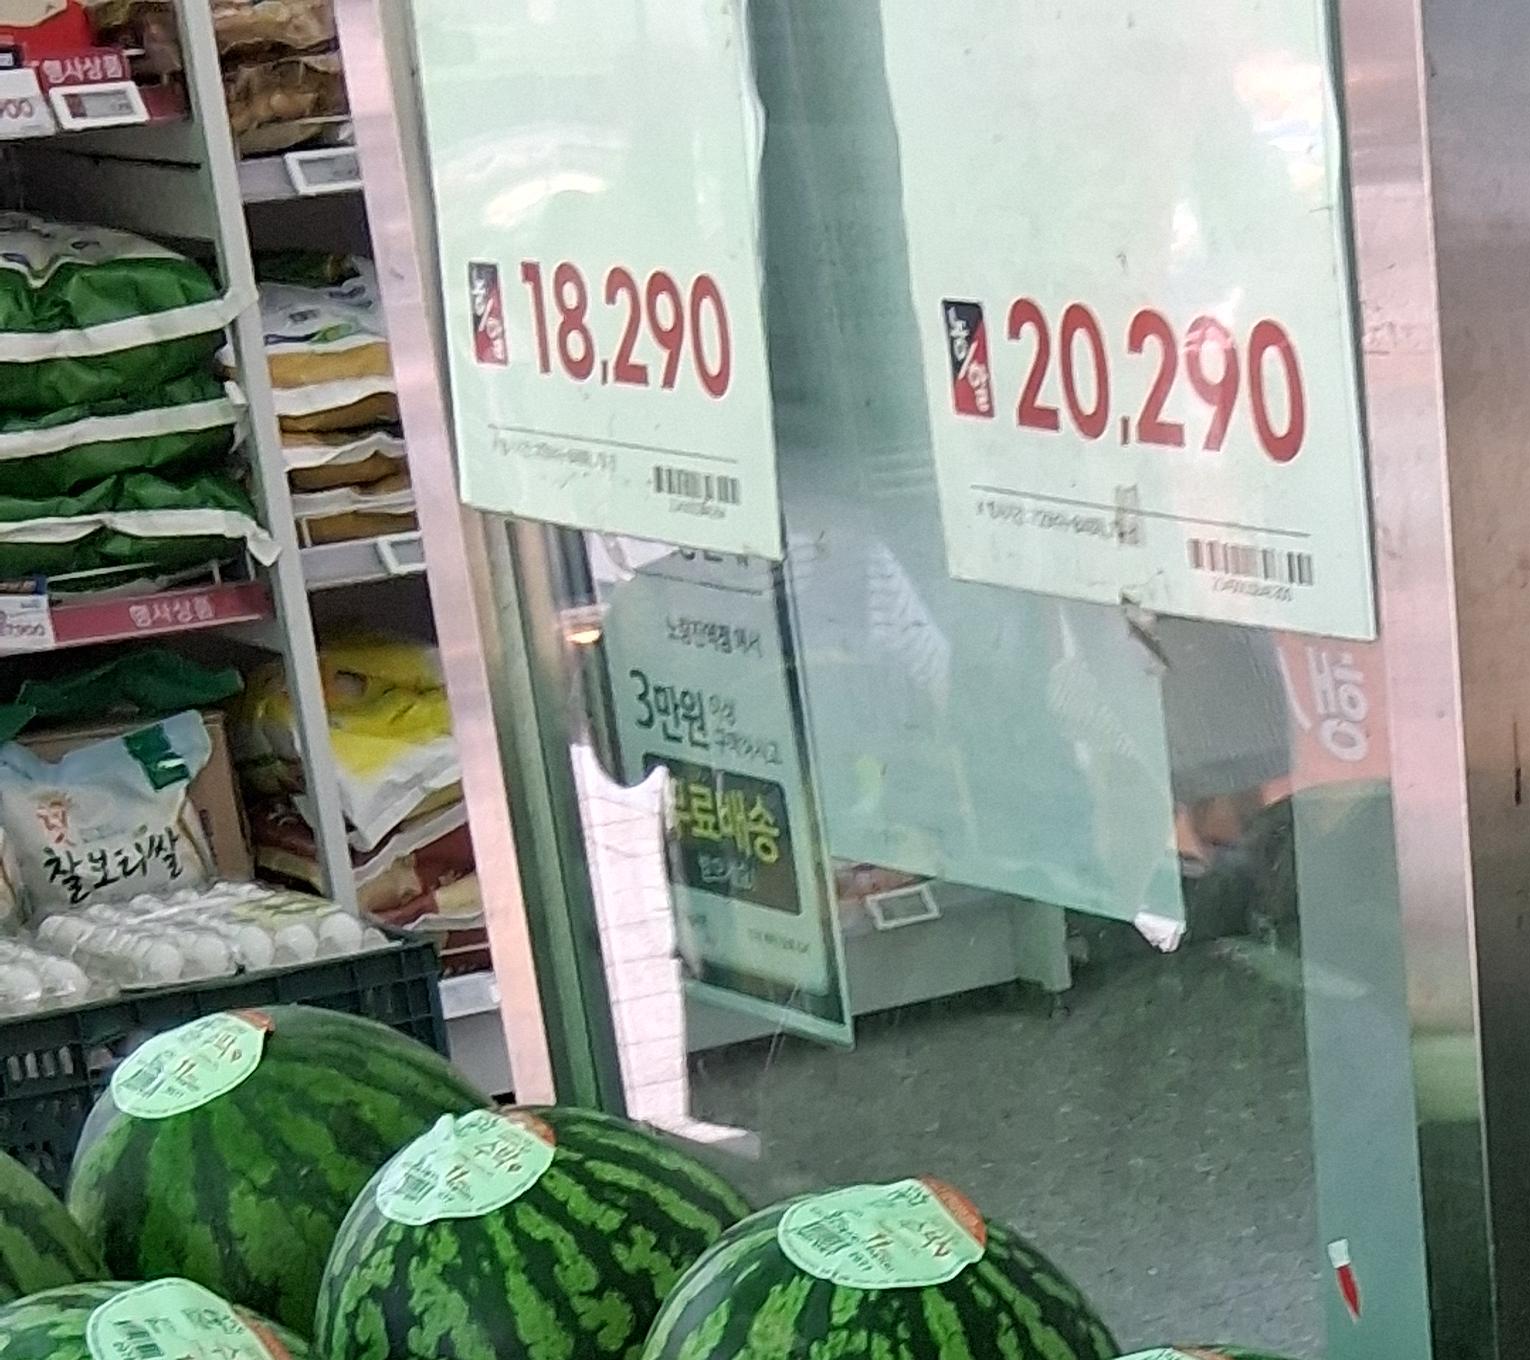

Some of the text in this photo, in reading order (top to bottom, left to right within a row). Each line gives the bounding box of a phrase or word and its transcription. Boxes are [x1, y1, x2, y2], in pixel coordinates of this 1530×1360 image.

[43, 54, 122, 84] 행사상품
[129, 597, 216, 628] 행사상품
[43, 825, 183, 904] 찰보리쌀
